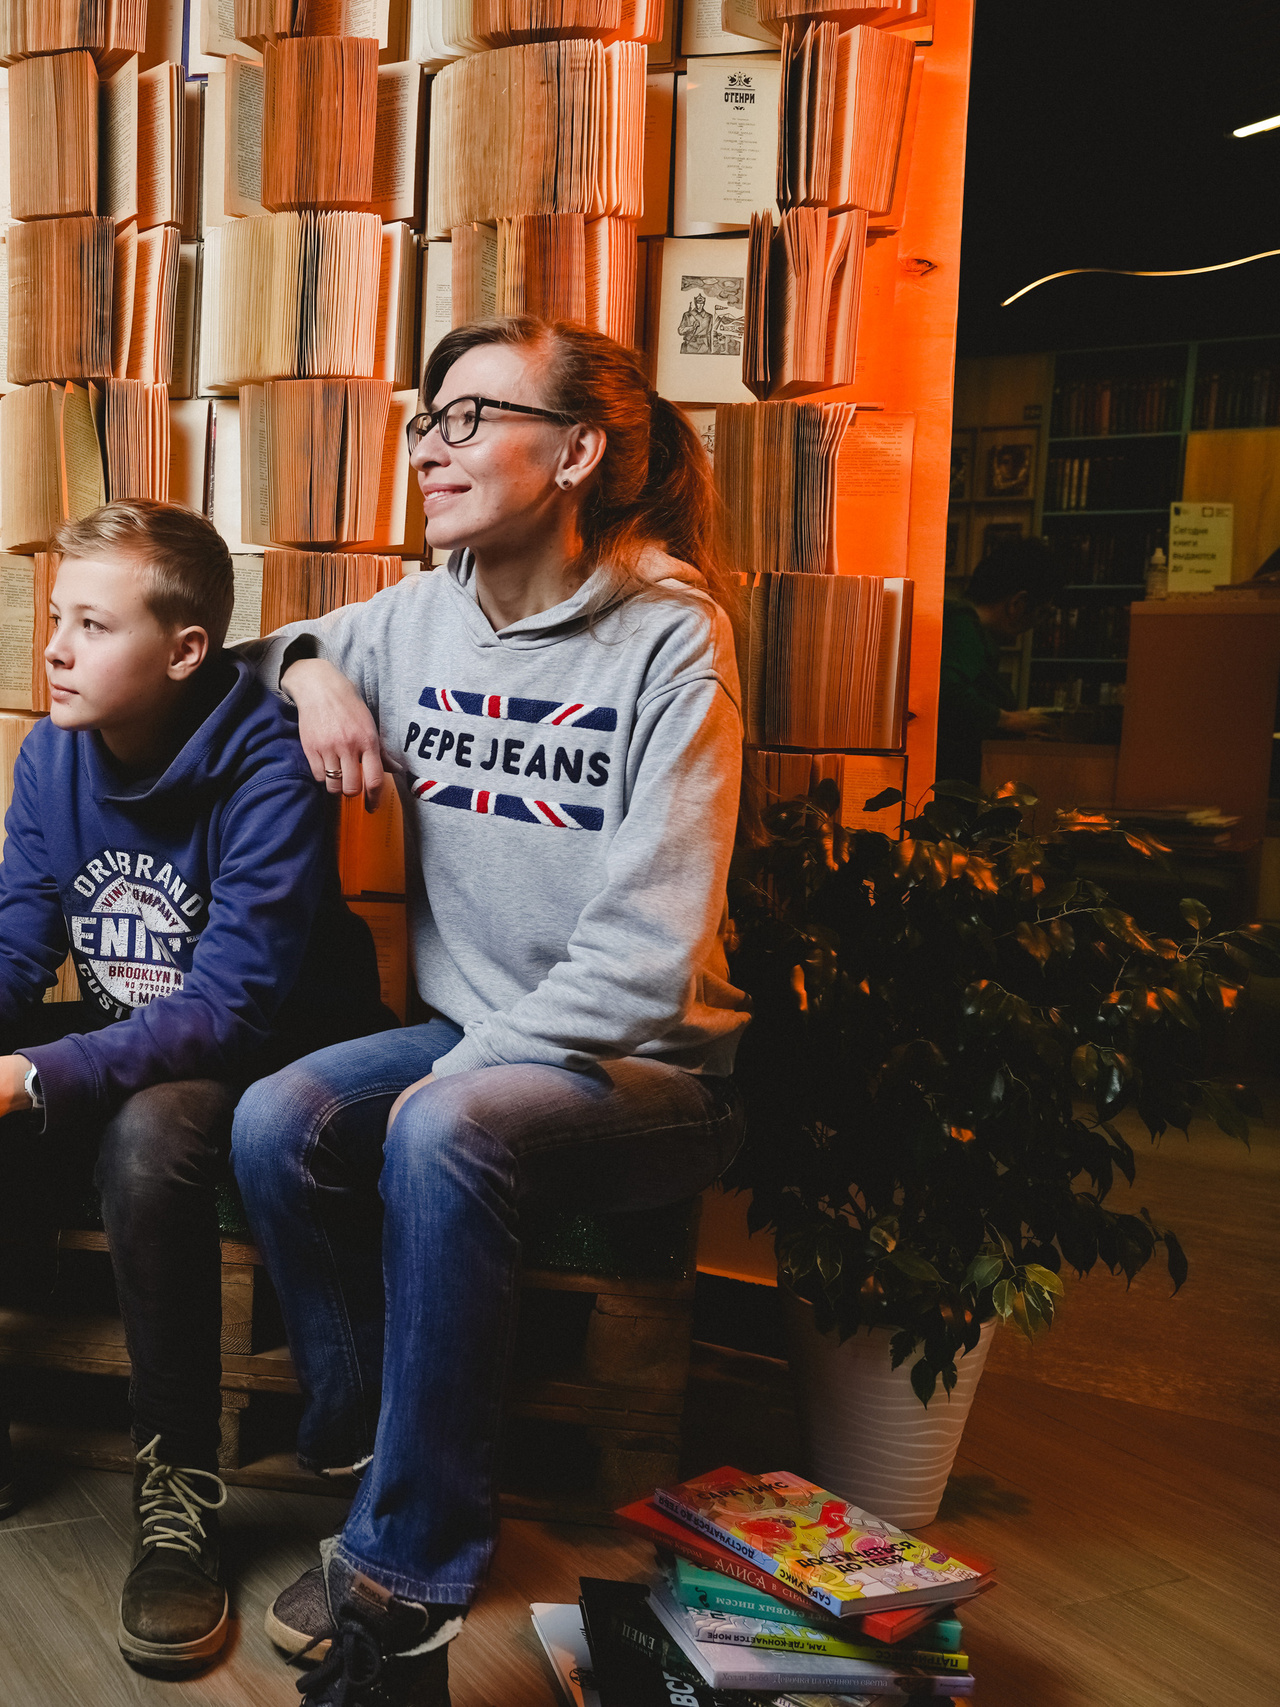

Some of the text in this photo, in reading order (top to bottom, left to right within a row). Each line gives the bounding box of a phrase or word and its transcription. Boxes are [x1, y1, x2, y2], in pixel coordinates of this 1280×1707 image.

[404, 721, 611, 787] PEPE JEANS
[101, 881, 180, 928] VINT OMPANY
[109, 965, 170, 984] BROOKLYN
[78, 963, 128, 1019] CUST
[696, 1488, 744, 1501] САРА
[692, 1515, 755, 1559] ДОСТУЧАТЬСЯ
[795, 1541, 917, 1568] ДОСТУЧАТЬСЯ
[834, 1554, 909, 1574] ДО ТЕБЯ
[714, 1558, 767, 1590] АЛИСА
[715, 1596, 756, 1610] писем
[808, 1586, 832, 1606] САРА
[707, 1632, 732, 1641] МОРЕ
[733, 1633, 787, 1648] КОНЧАЕТСЯ
[806, 1642, 827, 1652] ТАМ,
